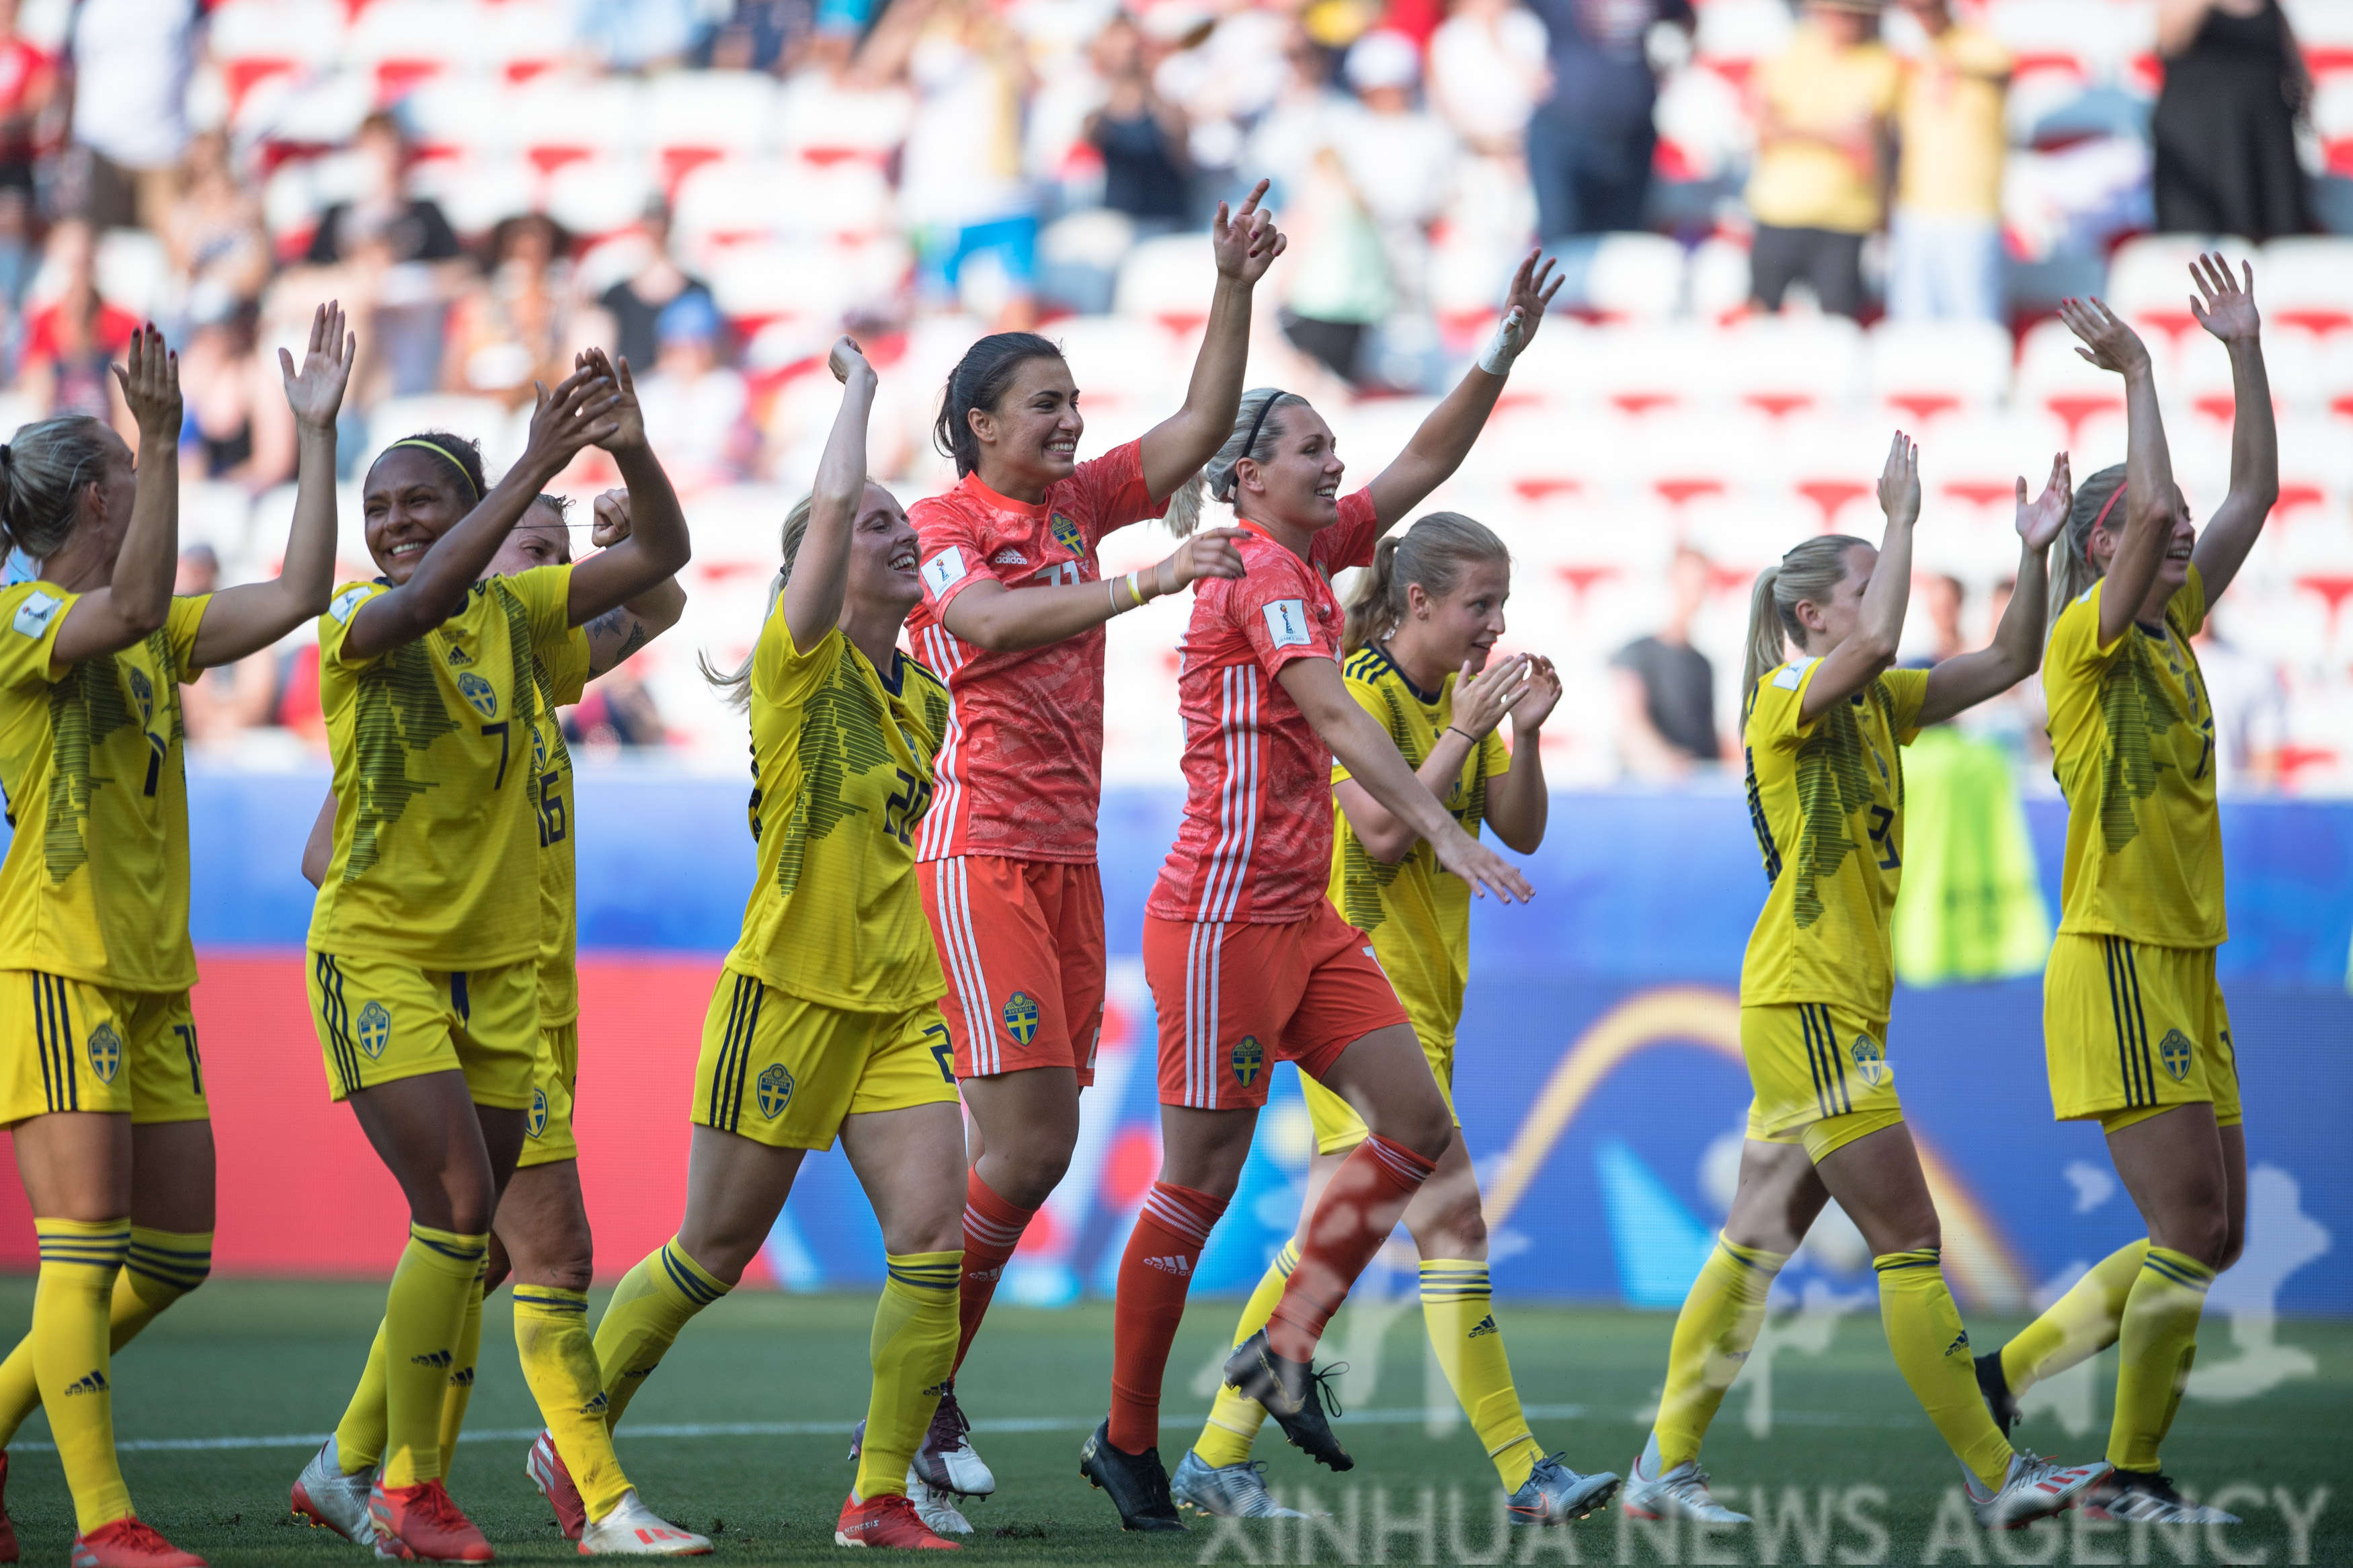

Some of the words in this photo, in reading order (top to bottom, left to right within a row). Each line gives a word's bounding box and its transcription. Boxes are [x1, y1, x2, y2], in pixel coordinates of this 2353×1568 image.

[995, 554, 1028, 565] adidas
[481, 722, 509, 791] 7
[1008, 1006, 1033, 1015] SVERIGE
[1143, 1257, 1193, 1276] adidas
[844, 1520, 879, 1533] NEMESIS
